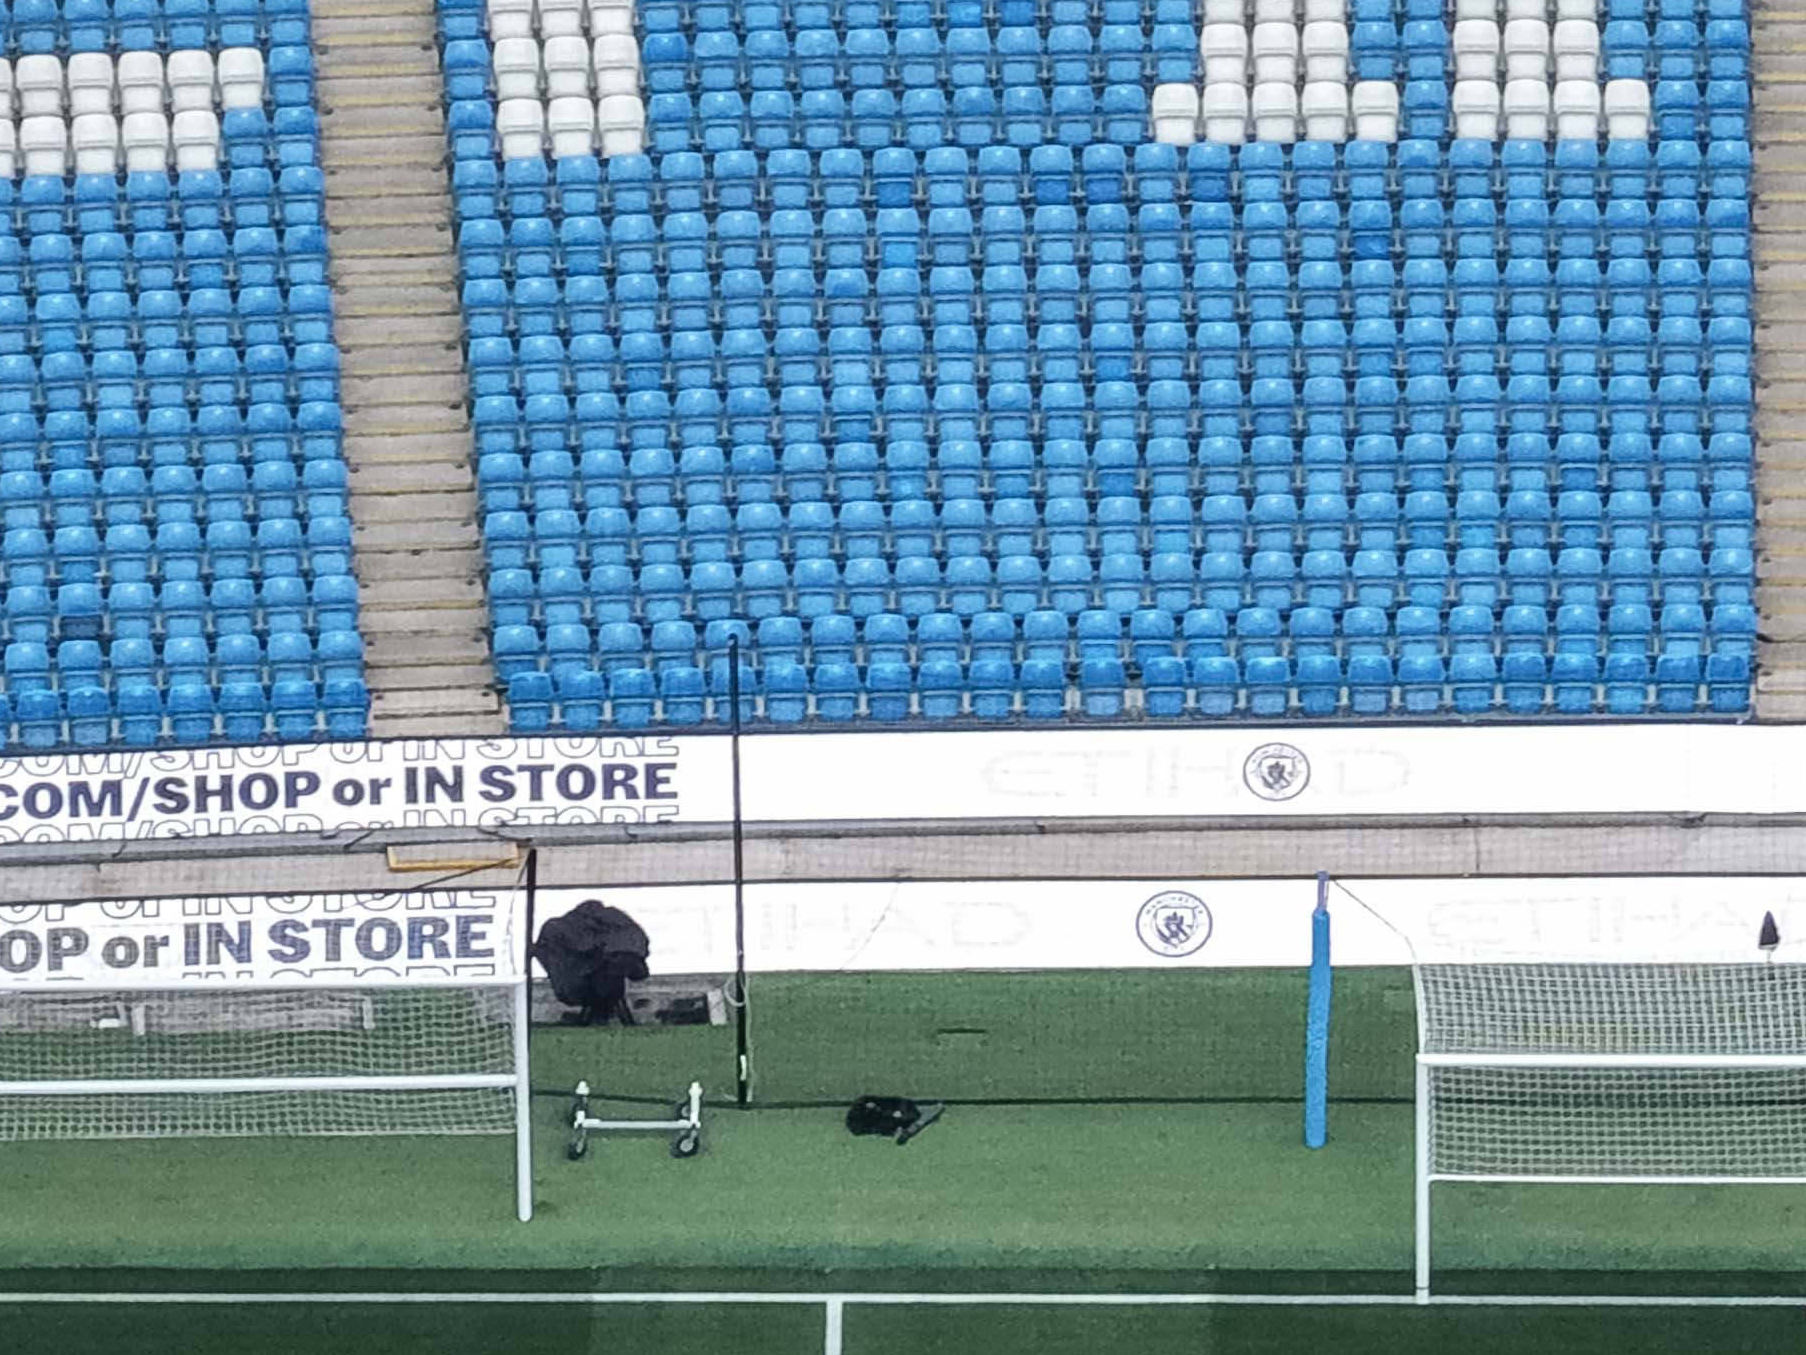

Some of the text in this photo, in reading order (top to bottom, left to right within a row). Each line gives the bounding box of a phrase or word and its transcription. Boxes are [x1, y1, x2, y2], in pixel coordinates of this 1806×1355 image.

[333, 778, 393, 808] or
[405, 765, 466, 806] IN
[480, 762, 679, 804] STORE
[101, 935, 169, 969] or
[183, 921, 252, 967] IN
[267, 914, 495, 964] STORE
